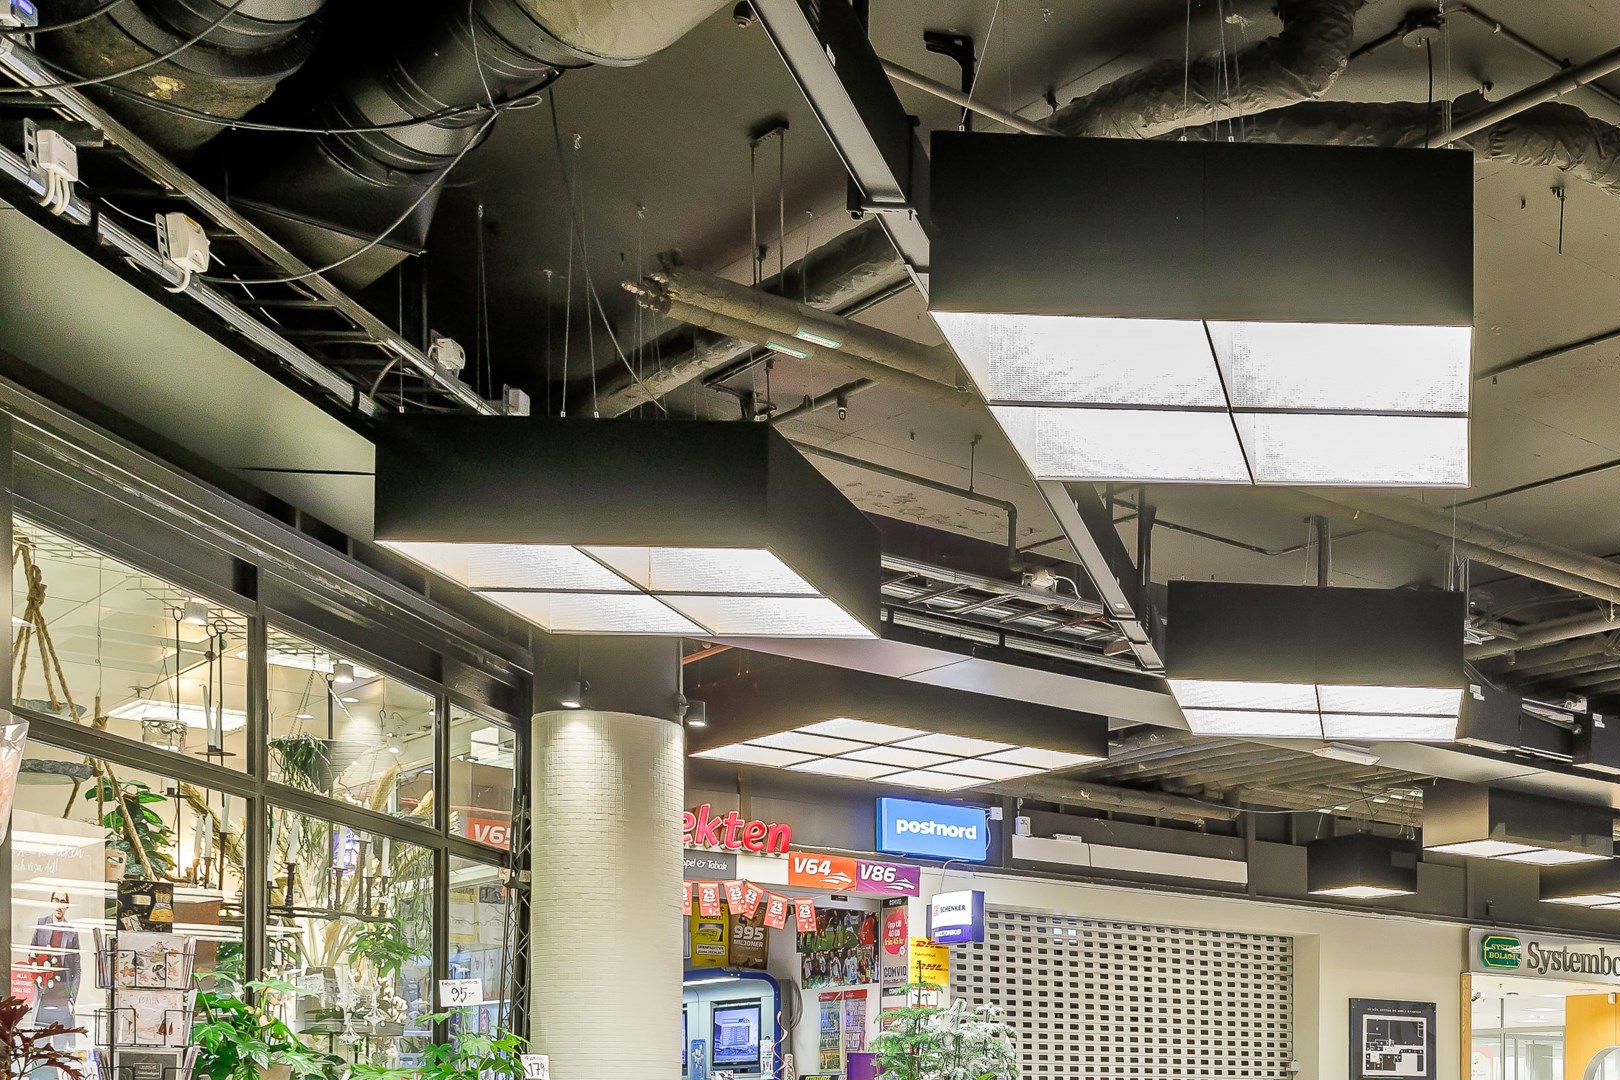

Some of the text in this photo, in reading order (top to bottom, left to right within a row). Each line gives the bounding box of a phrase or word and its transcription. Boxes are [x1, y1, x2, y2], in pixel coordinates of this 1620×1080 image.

[896, 818, 977, 840] postnord
[707, 859, 729, 871] Tobak
[793, 856, 832, 876] V64
[859, 863, 897, 883] V86
[703, 888, 716, 898] 25
[729, 887, 742, 897] 25
[745, 889, 757, 901] 25
[771, 900, 783, 912] 25
[799, 904, 811, 915] 25
[940, 905, 966, 914] SCHENKER
[733, 925, 765, 941] 995
